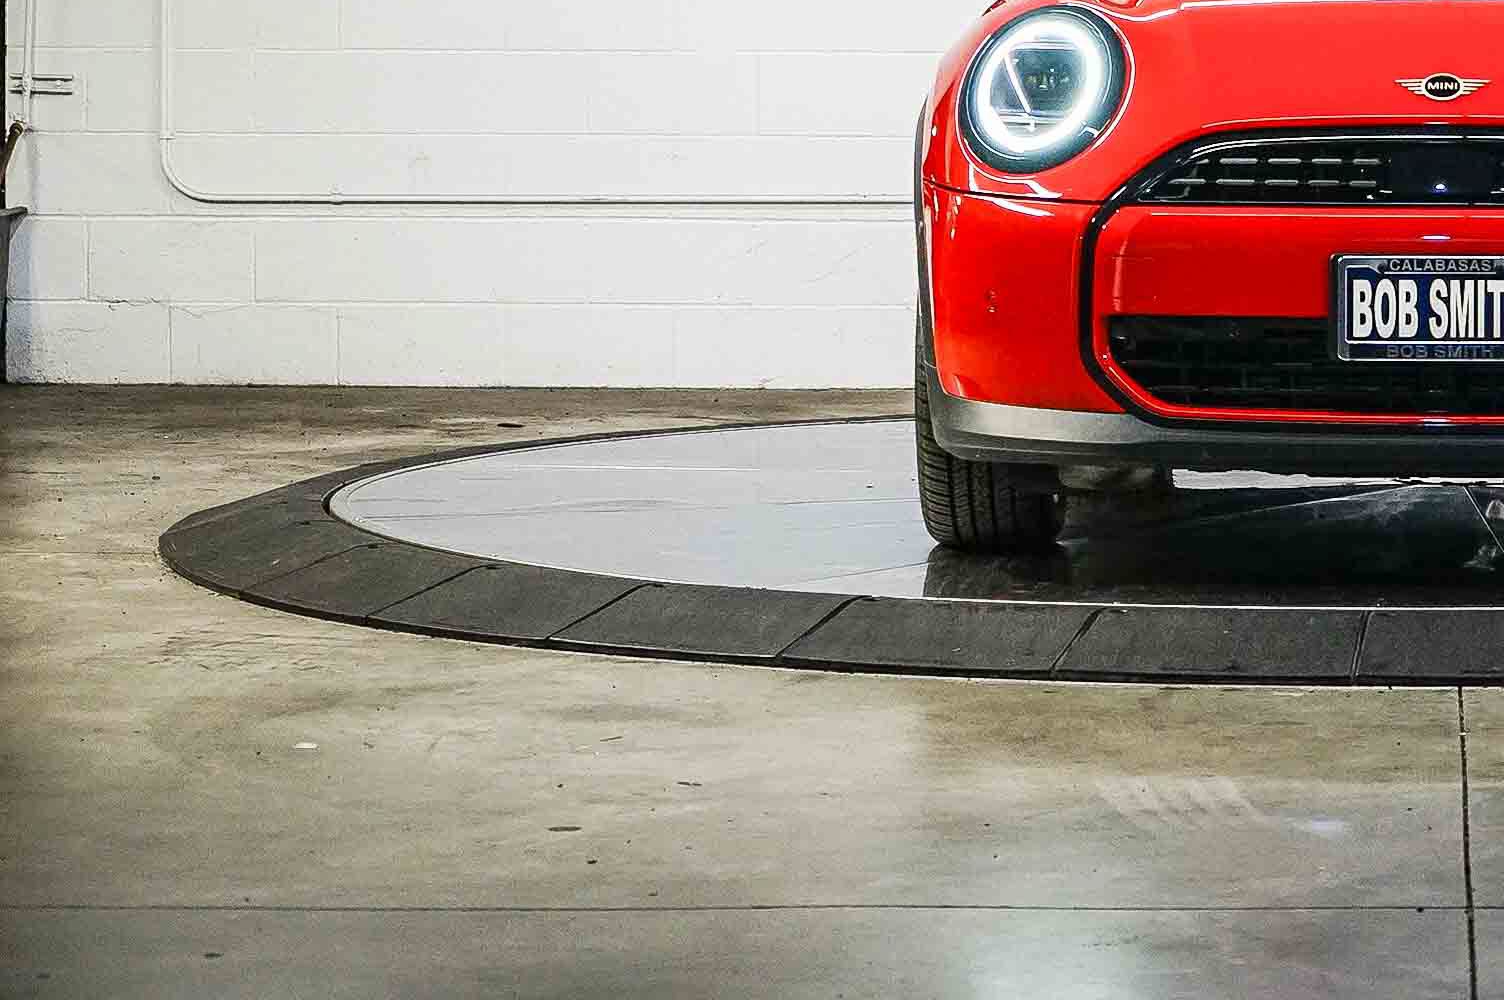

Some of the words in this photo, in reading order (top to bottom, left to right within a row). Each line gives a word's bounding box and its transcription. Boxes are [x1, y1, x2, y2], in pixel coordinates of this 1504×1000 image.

[1427, 81, 1459, 91] MINI
[1389, 259, 1492, 271] CALABASAS
[1352, 278, 1419, 338] BOB
[1386, 344, 1429, 358] BOB
[1433, 344, 1496, 358] SMITH
